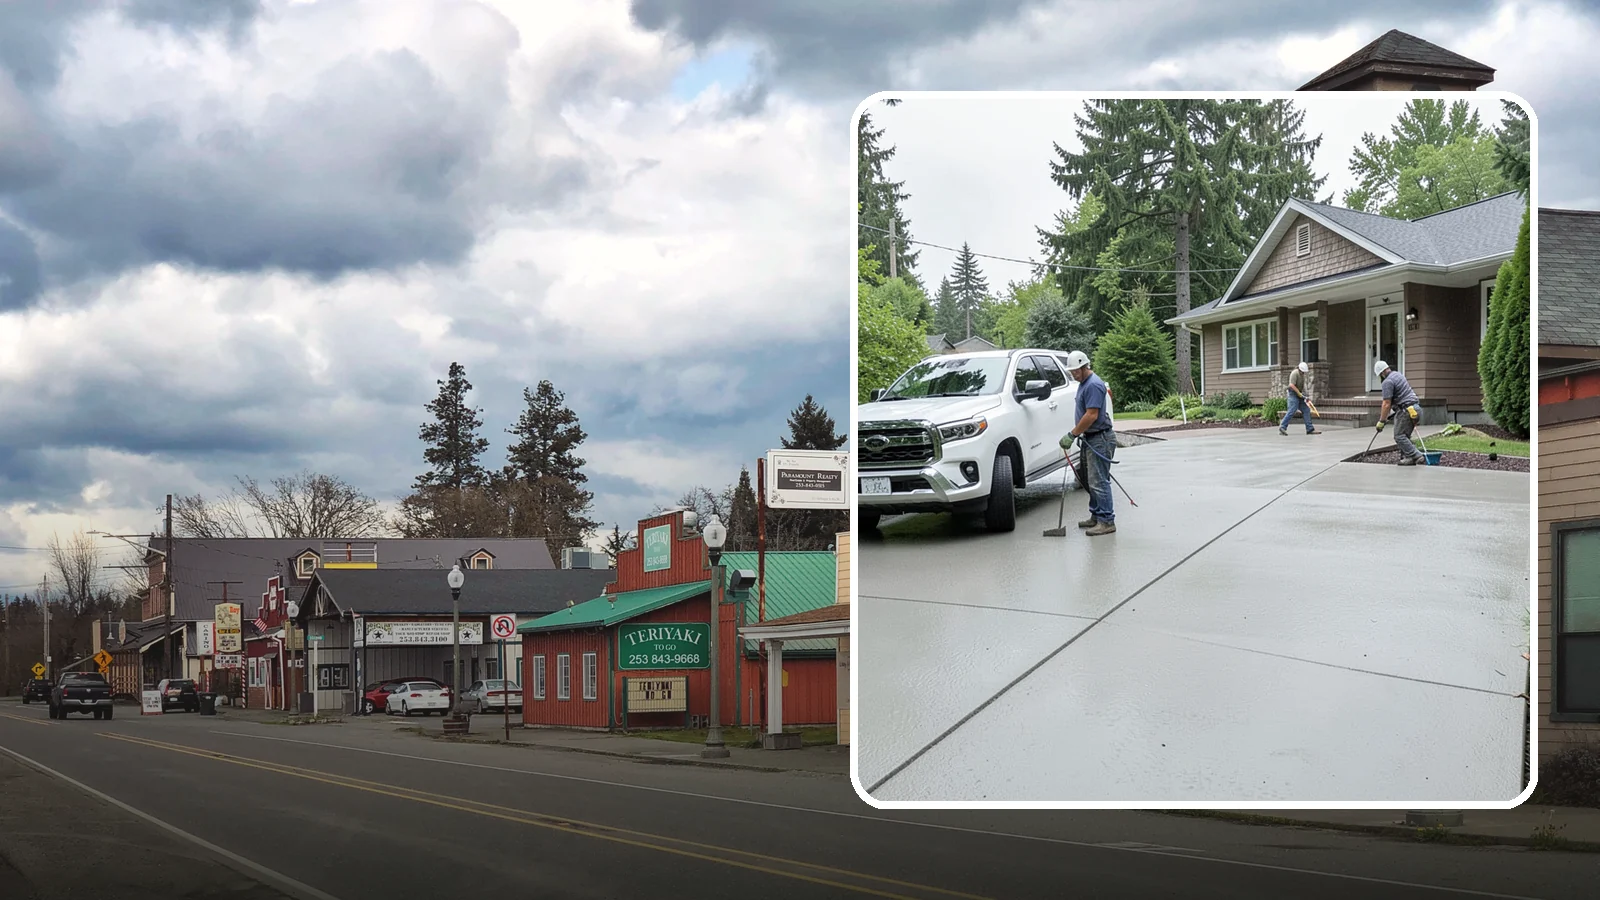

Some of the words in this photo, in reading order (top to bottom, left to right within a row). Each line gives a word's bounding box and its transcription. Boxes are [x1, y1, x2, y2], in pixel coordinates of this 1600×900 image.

[781, 471, 815, 479] PARAMOUNT
[817, 472, 839, 480] REALTY
[624, 627, 702, 646] TERIYAKI
[629, 654, 648, 664] 253
[651, 653, 700, 664] 843-9668
[639, 681, 672, 691] TERIYAKI
